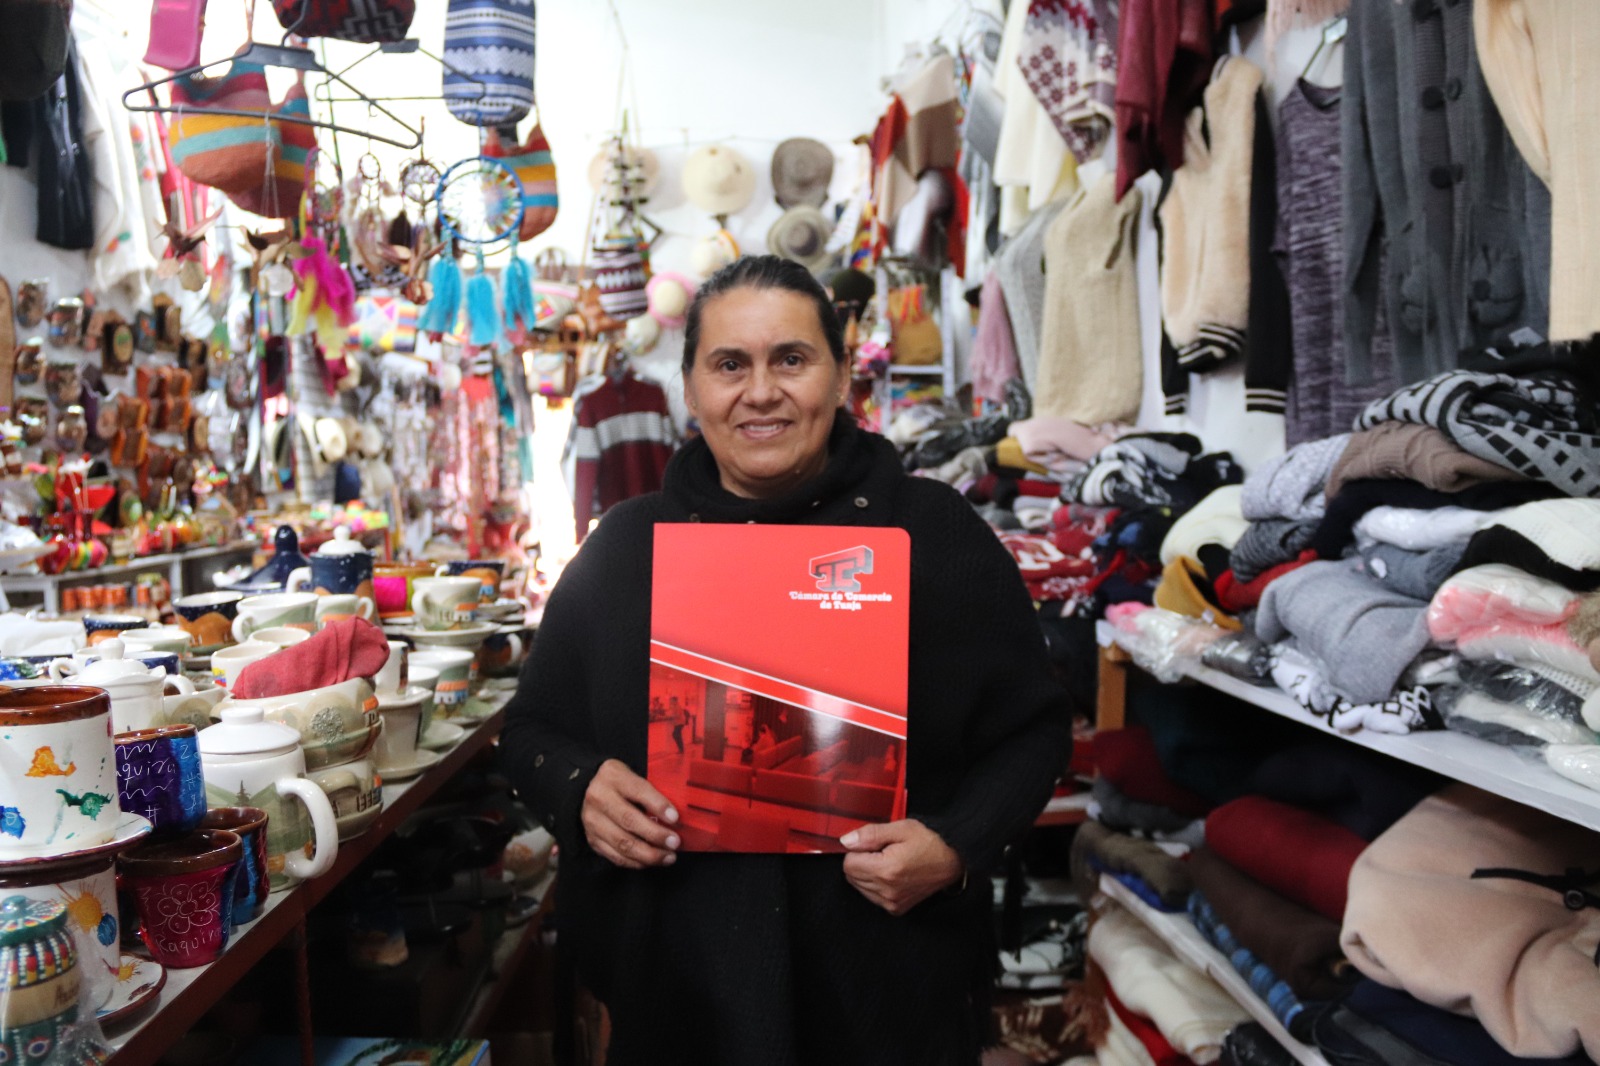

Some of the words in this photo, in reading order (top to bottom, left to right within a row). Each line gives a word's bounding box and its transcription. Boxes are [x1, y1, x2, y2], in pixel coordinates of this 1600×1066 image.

[831, 592, 844, 601] de
[844, 592, 893, 602] Comercio
[820, 600, 832, 609] de
[833, 601, 862, 611] Tunja
